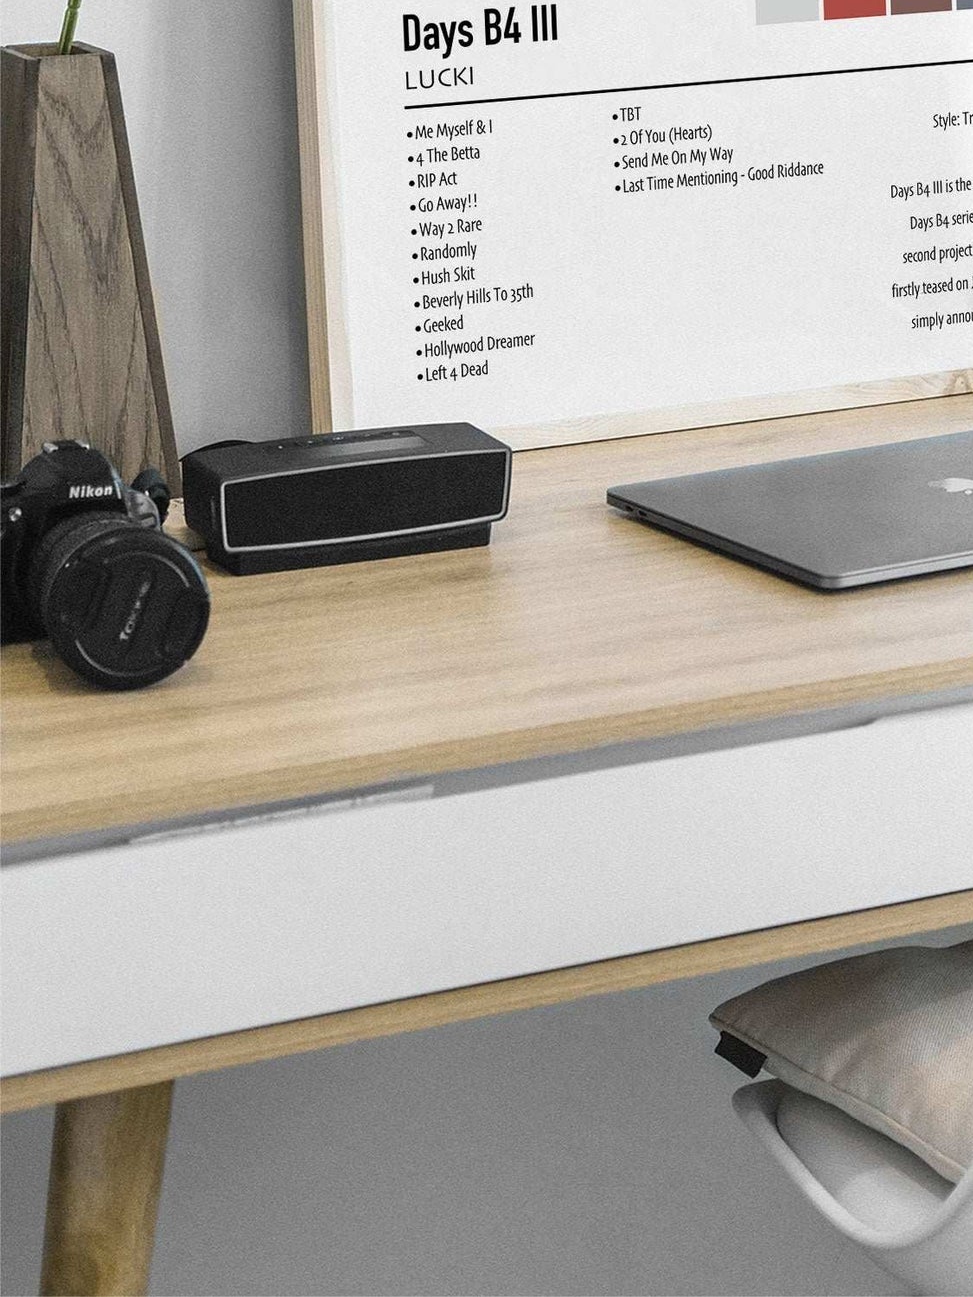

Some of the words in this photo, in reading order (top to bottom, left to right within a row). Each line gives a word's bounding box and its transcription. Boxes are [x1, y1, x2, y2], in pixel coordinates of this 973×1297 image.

[402, 13, 474, 60] Days
[483, 6, 522, 46] B4
[531, 3, 558, 43] III
[405, 66, 474, 91] LUCKI
[619, 106, 642, 122] TBT
[932, 111, 961, 132] Style:
[415, 124, 434, 140] Me
[436, 119, 474, 142] Myself
[476, 119, 487, 135] &
[489, 118, 493, 134] I
[620, 133, 628, 146] 2
[629, 128, 644, 144] Of
[645, 129, 667, 144] You
[668, 123, 713, 145] (Hearts)
[415, 152, 425, 167] 4
[425, 146, 448, 163] The
[450, 146, 481, 161] Betta
[621, 152, 649, 170] Send
[651, 152, 669, 167] Me
[671, 150, 687, 165] On
[689, 148, 707, 167] My
[709, 146, 734, 164] Way
[417, 172, 437, 189] RIP
[438, 171, 458, 187] Act
[622, 178, 645, 194] Last
[646, 175, 674, 191] Time
[676, 169, 738, 188] Mentioning
[747, 163, 775, 181] Good
[777, 161, 824, 179] Riddance
[890, 184, 915, 202] Days
[916, 181, 931, 198] B4
[932, 180, 943, 195] III
[945, 179, 954, 193] is
[954, 176, 972, 192] the
[418, 197, 434, 213] Go
[436, 193, 479, 213] Away!!
[418, 221, 445, 240] Way
[447, 222, 455, 235] 2
[456, 218, 483, 234] Rare
[910, 215, 934, 232] Days
[935, 213, 950, 229] B4
[420, 240, 477, 262] Randomly
[902, 245, 937, 264] second
[939, 243, 973, 264] project
[421, 267, 451, 286] Hush
[453, 265, 476, 283] Skit
[422, 290, 464, 310] Beverly
[466, 287, 492, 305] Hills
[492, 286, 508, 302] To
[510, 282, 534, 304] 35th
[891, 281, 921, 300] firstly
[922, 276, 954, 295] teased
[955, 279, 969, 291] on
[423, 314, 464, 334] Geeked
[911, 311, 945, 331] simply
[424, 335, 484, 360] Hollywood
[487, 334, 536, 351] Dreamer
[425, 364, 448, 382] Left
[449, 367, 458, 382] 4
[460, 359, 489, 378] Dead
[68, 484, 114, 500] Nikon
